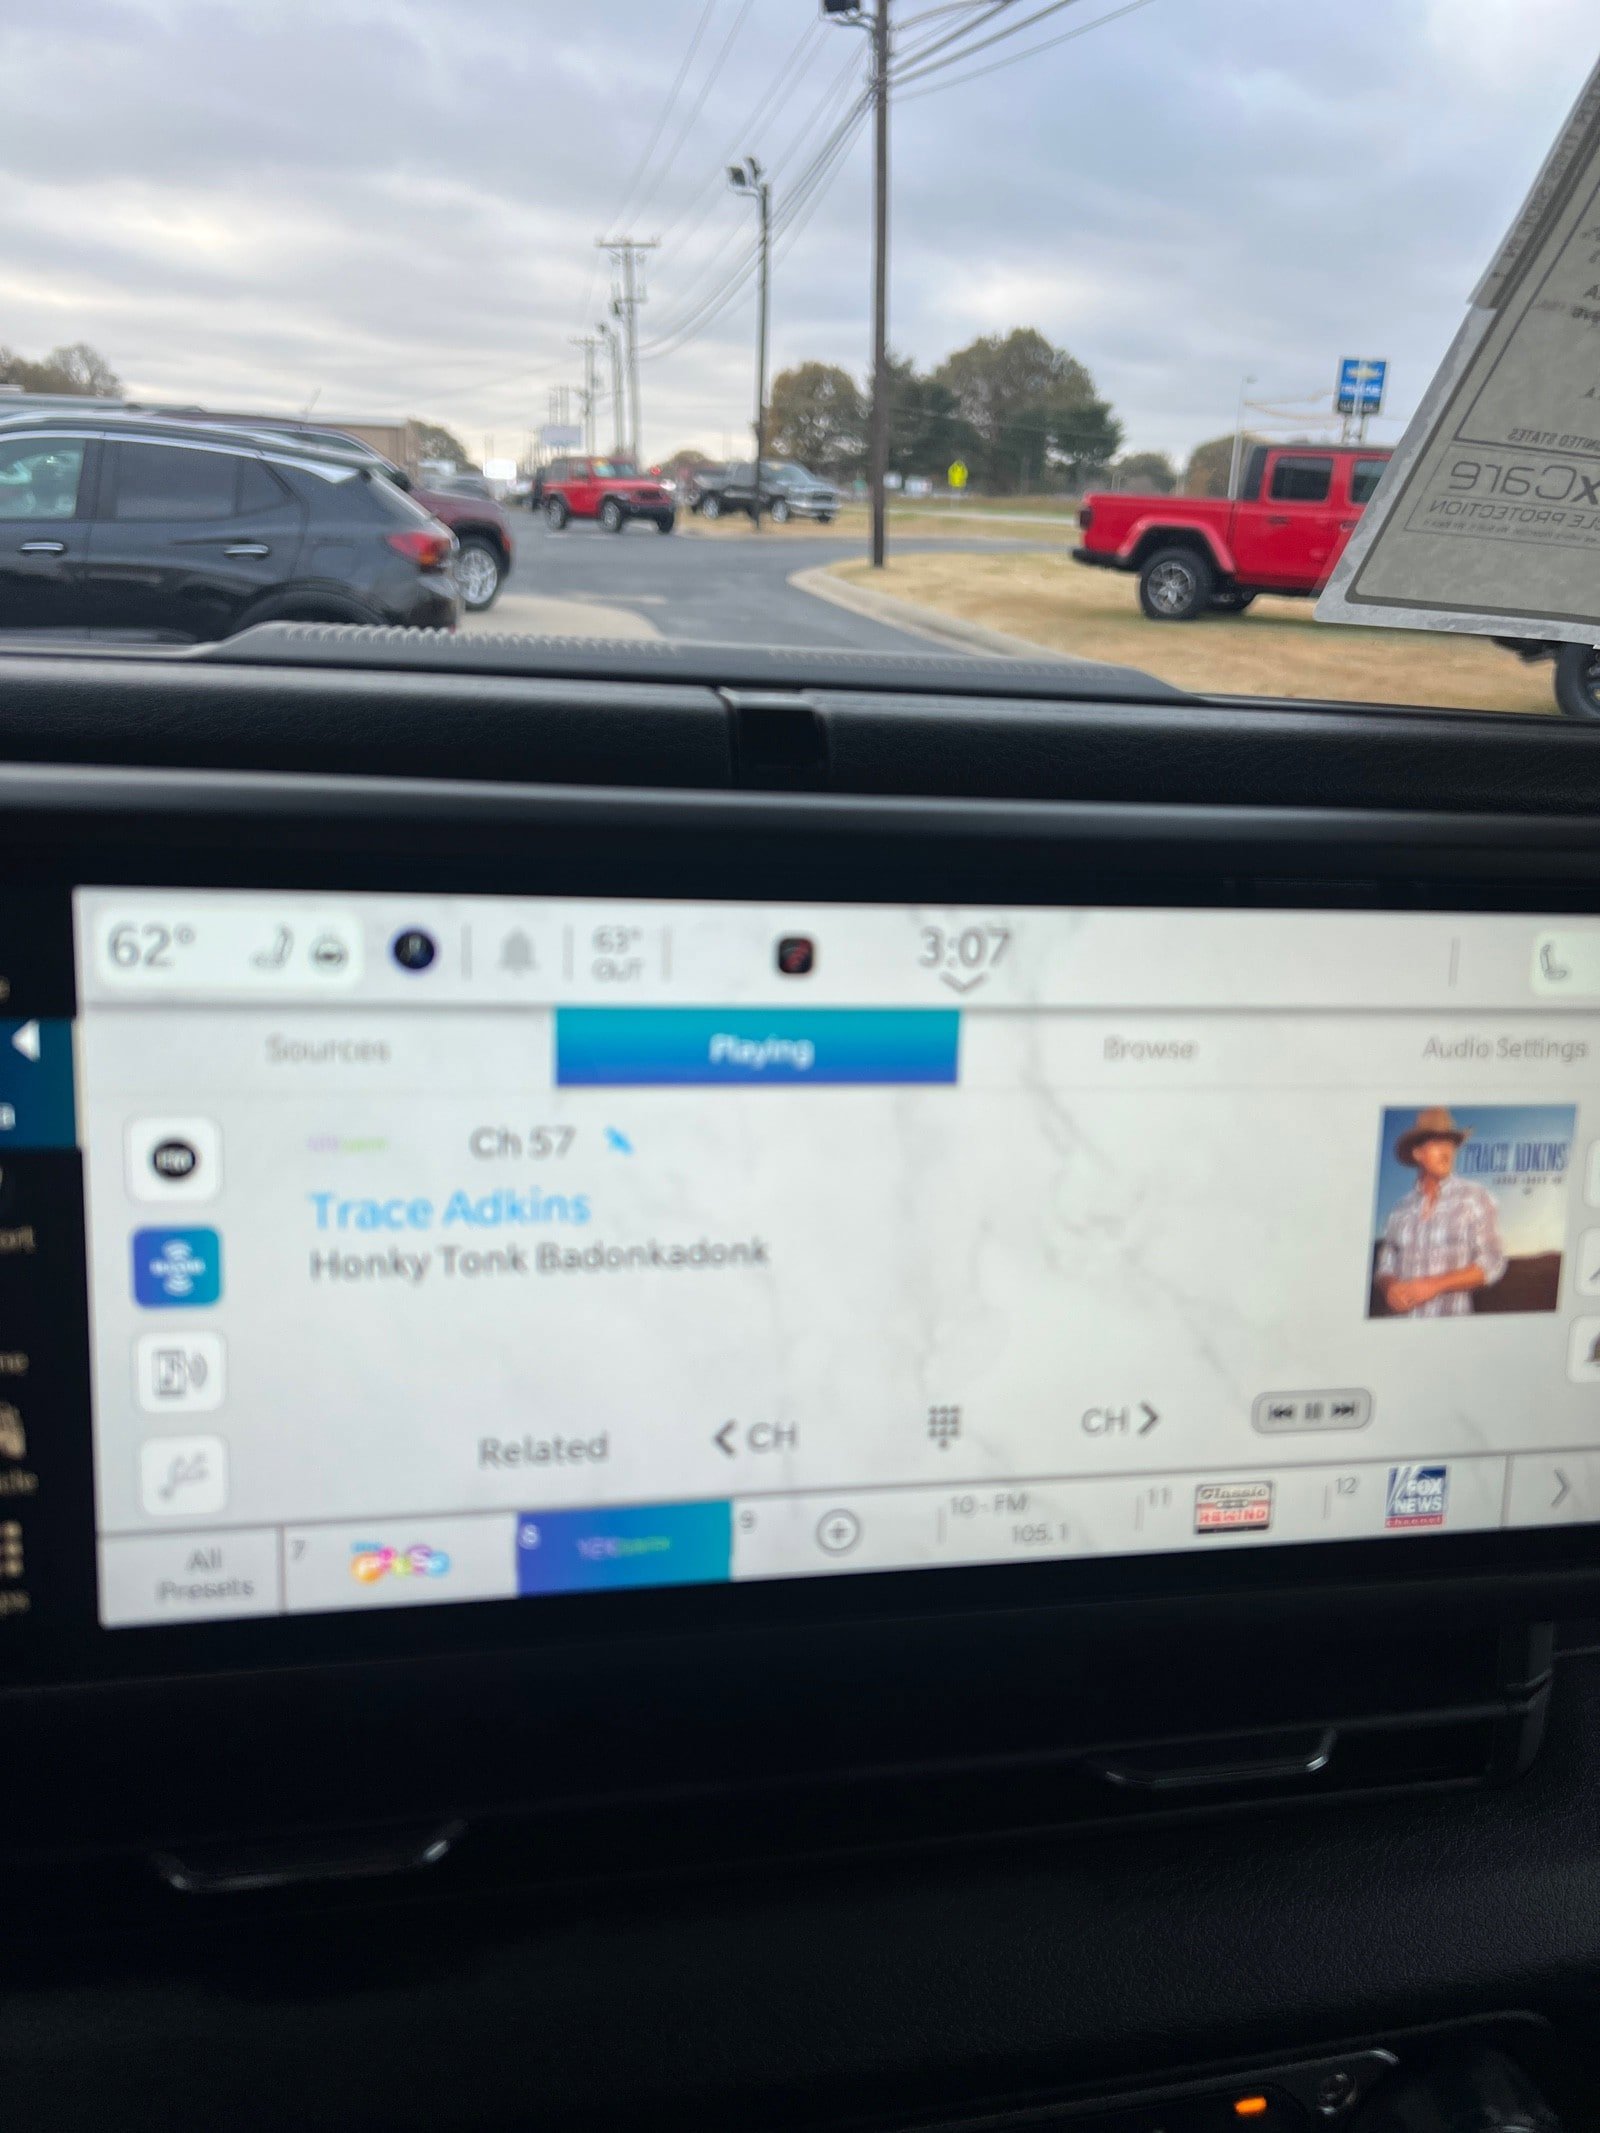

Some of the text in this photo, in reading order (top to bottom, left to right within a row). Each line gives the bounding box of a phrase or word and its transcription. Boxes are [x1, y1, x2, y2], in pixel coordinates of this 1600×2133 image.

[919, 927, 1012, 968] 3:07
[264, 1034, 391, 1064] Sources
[708, 1034, 814, 1068] Playing
[1103, 1037, 1198, 1061] Browse
[1423, 1036, 1589, 1065] Audio Settings
[468, 1125, 577, 1160] Ch 57
[309, 1188, 592, 1231] Trace Adkins
[309, 1238, 770, 1286] Honky Tonk Badonkadonk
[1081, 1406, 1128, 1434] CH
[478, 1431, 609, 1468] Related
[747, 1422, 798, 1452] CH
[1148, 1488, 1172, 1506] 11
[1200, 1484, 1267, 1501] Classic
[1334, 1477, 1359, 1495] 12
[1405, 1477, 1443, 1497] FOX
[993, 1492, 1030, 1513] FM
[1199, 1510, 1266, 1523] REWIND
[1394, 1496, 1442, 1514] NEWS
[186, 1547, 222, 1570] All
[158, 1573, 255, 1602] Presets
